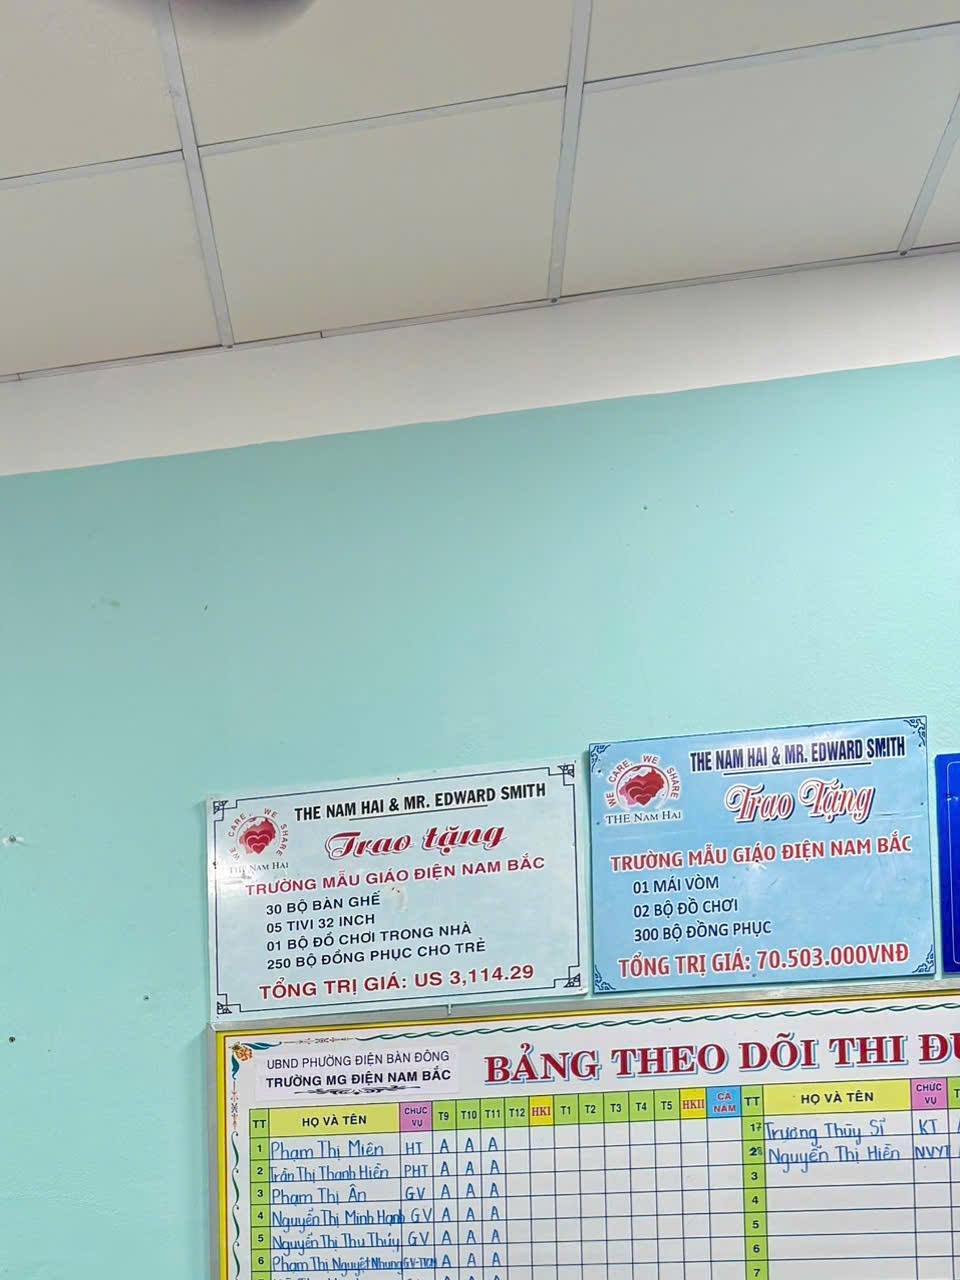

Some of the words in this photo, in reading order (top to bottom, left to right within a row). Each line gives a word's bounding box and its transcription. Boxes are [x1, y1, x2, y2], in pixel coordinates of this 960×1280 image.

[690, 751, 712, 772] THE
[716, 749, 743, 770] NAM
[748, 747, 767, 767] HAI
[772, 746, 780, 765] &
[785, 744, 807, 764] MR.
[812, 740, 862, 762] EDWARD
[867, 736, 905, 758] SMITH
[295, 806, 320, 821] THE
[327, 802, 356, 818] NAM
[362, 799, 384, 815] HAI
[390, 798, 399, 812] &
[404, 796, 429, 810] MR.
[435, 788, 496, 806] EDWARD
[501, 783, 546, 800] SMITH
[725, 784, 795, 821] Trao
[799, 778, 876, 824] Tặng
[606, 814, 630, 824] THE
[325, 832, 414, 860] Trao
[422, 825, 508, 856] tặng
[611, 849, 682, 871] TRƯỜNG
[690, 844, 727, 864] MẪU
[733, 845, 776, 862] GIÁO
[782, 840, 824, 861] ĐIỆN
[831, 839, 870, 856] NAM
[878, 832, 912, 852] BẮC
[245, 879, 316, 895] TRƯỜNG
[323, 870, 359, 888] MẪU
[366, 869, 408, 884] GIÁO
[414, 864, 455, 880] ĐIỆN
[462, 861, 500, 875] NAM
[508, 853, 545, 871] BẮC
[633, 882, 649, 894] 01
[653, 876, 681, 892] MÁI
[685, 874, 719, 890] VÒM
[266, 904, 282, 915] 30
[287, 901, 308, 914] BỘ
[312, 898, 343, 910] BÀN
[349, 890, 380, 907] GHẾ
[633, 905, 649, 918] 02
[654, 900, 673, 918] BỘ
[678, 897, 698, 915] ĐỒ
[703, 899, 738, 912] CHƠI
[266, 923, 282, 933] 05
[287, 920, 313, 931] TIVI
[318, 918, 334, 928] 32
[340, 914, 375, 927] INCH
[634, 928, 658, 942] 300
[663, 924, 682, 942] BỘ
[686, 920, 728, 938] ĐỒNG
[733, 921, 772, 937] PHỤC
[266, 941, 281, 951] 01
[288, 937, 308, 950] BỘ
[339, 932, 375, 945] CHƠI
[380, 927, 433, 941] TRONG
[439, 921, 472, 936] NHÀ
[267, 958, 291, 970] 250
[296, 954, 316, 968] BỘ
[370, 948, 412, 962] PHỤC
[418, 945, 450, 957] CHO
[455, 937, 485, 953] TRẺ
[619, 952, 669, 977] TỔNG
[676, 954, 706, 976] TRỊ
[712, 948, 750, 971] GIÁ:
[757, 943, 909, 969] 70.503.000VNĐ
[259, 977, 317, 999] TỔNG
[324, 979, 357, 995] TRỊ
[364, 972, 406, 992] GIÁ:
[415, 972, 442, 987] US
[450, 965, 533, 986] 3,114.29
[267, 1059, 298, 1069] UBND
[303, 1053, 351, 1068] PHƯỜNG
[355, 1052, 383, 1066] ĐIỆN
[387, 1050, 411, 1064] BÀN
[415, 1049, 449, 1062] ĐÔNG
[484, 1043, 602, 1085] BẢNG
[611, 1044, 729, 1078] THEO
[739, 1034, 819, 1071] DÕI
[829, 1035, 908, 1067] THI
[266, 1074, 321, 1088] TRƯỜNG
[326, 1074, 346, 1085] MG
[352, 1071, 383, 1085] ĐIỆN
[388, 1071, 417, 1082] NAM
[423, 1066, 451, 1081] BẮC
[917, 1083, 941, 1092] CHỨC
[661, 1101, 672, 1110] T5
[682, 1099, 704, 1110] HKII
[744, 1097, 760, 1106] TT
[801, 1094, 820, 1106] HỌ
[825, 1091, 842, 1103] VÀ
[847, 1090, 873, 1101] TÊN
[925, 1097, 937, 1105] VỤ
[461, 1110, 477, 1119] T10
[485, 1109, 500, 1118] T11
[509, 1108, 525, 1117] T12
[532, 1107, 551, 1116] HKI
[561, 1106, 571, 1115] T1
[585, 1105, 596, 1114] T2
[610, 1103, 621, 1113] T3
[636, 1102, 647, 1111] T4
[303, 1117, 319, 1128] HỌ
[324, 1114, 338, 1126] VÀ
[343, 1114, 367, 1125] TÊN
[438, 1111, 449, 1120] T9
[252, 1120, 266, 1128] TT
[405, 1141, 422, 1154] HT
